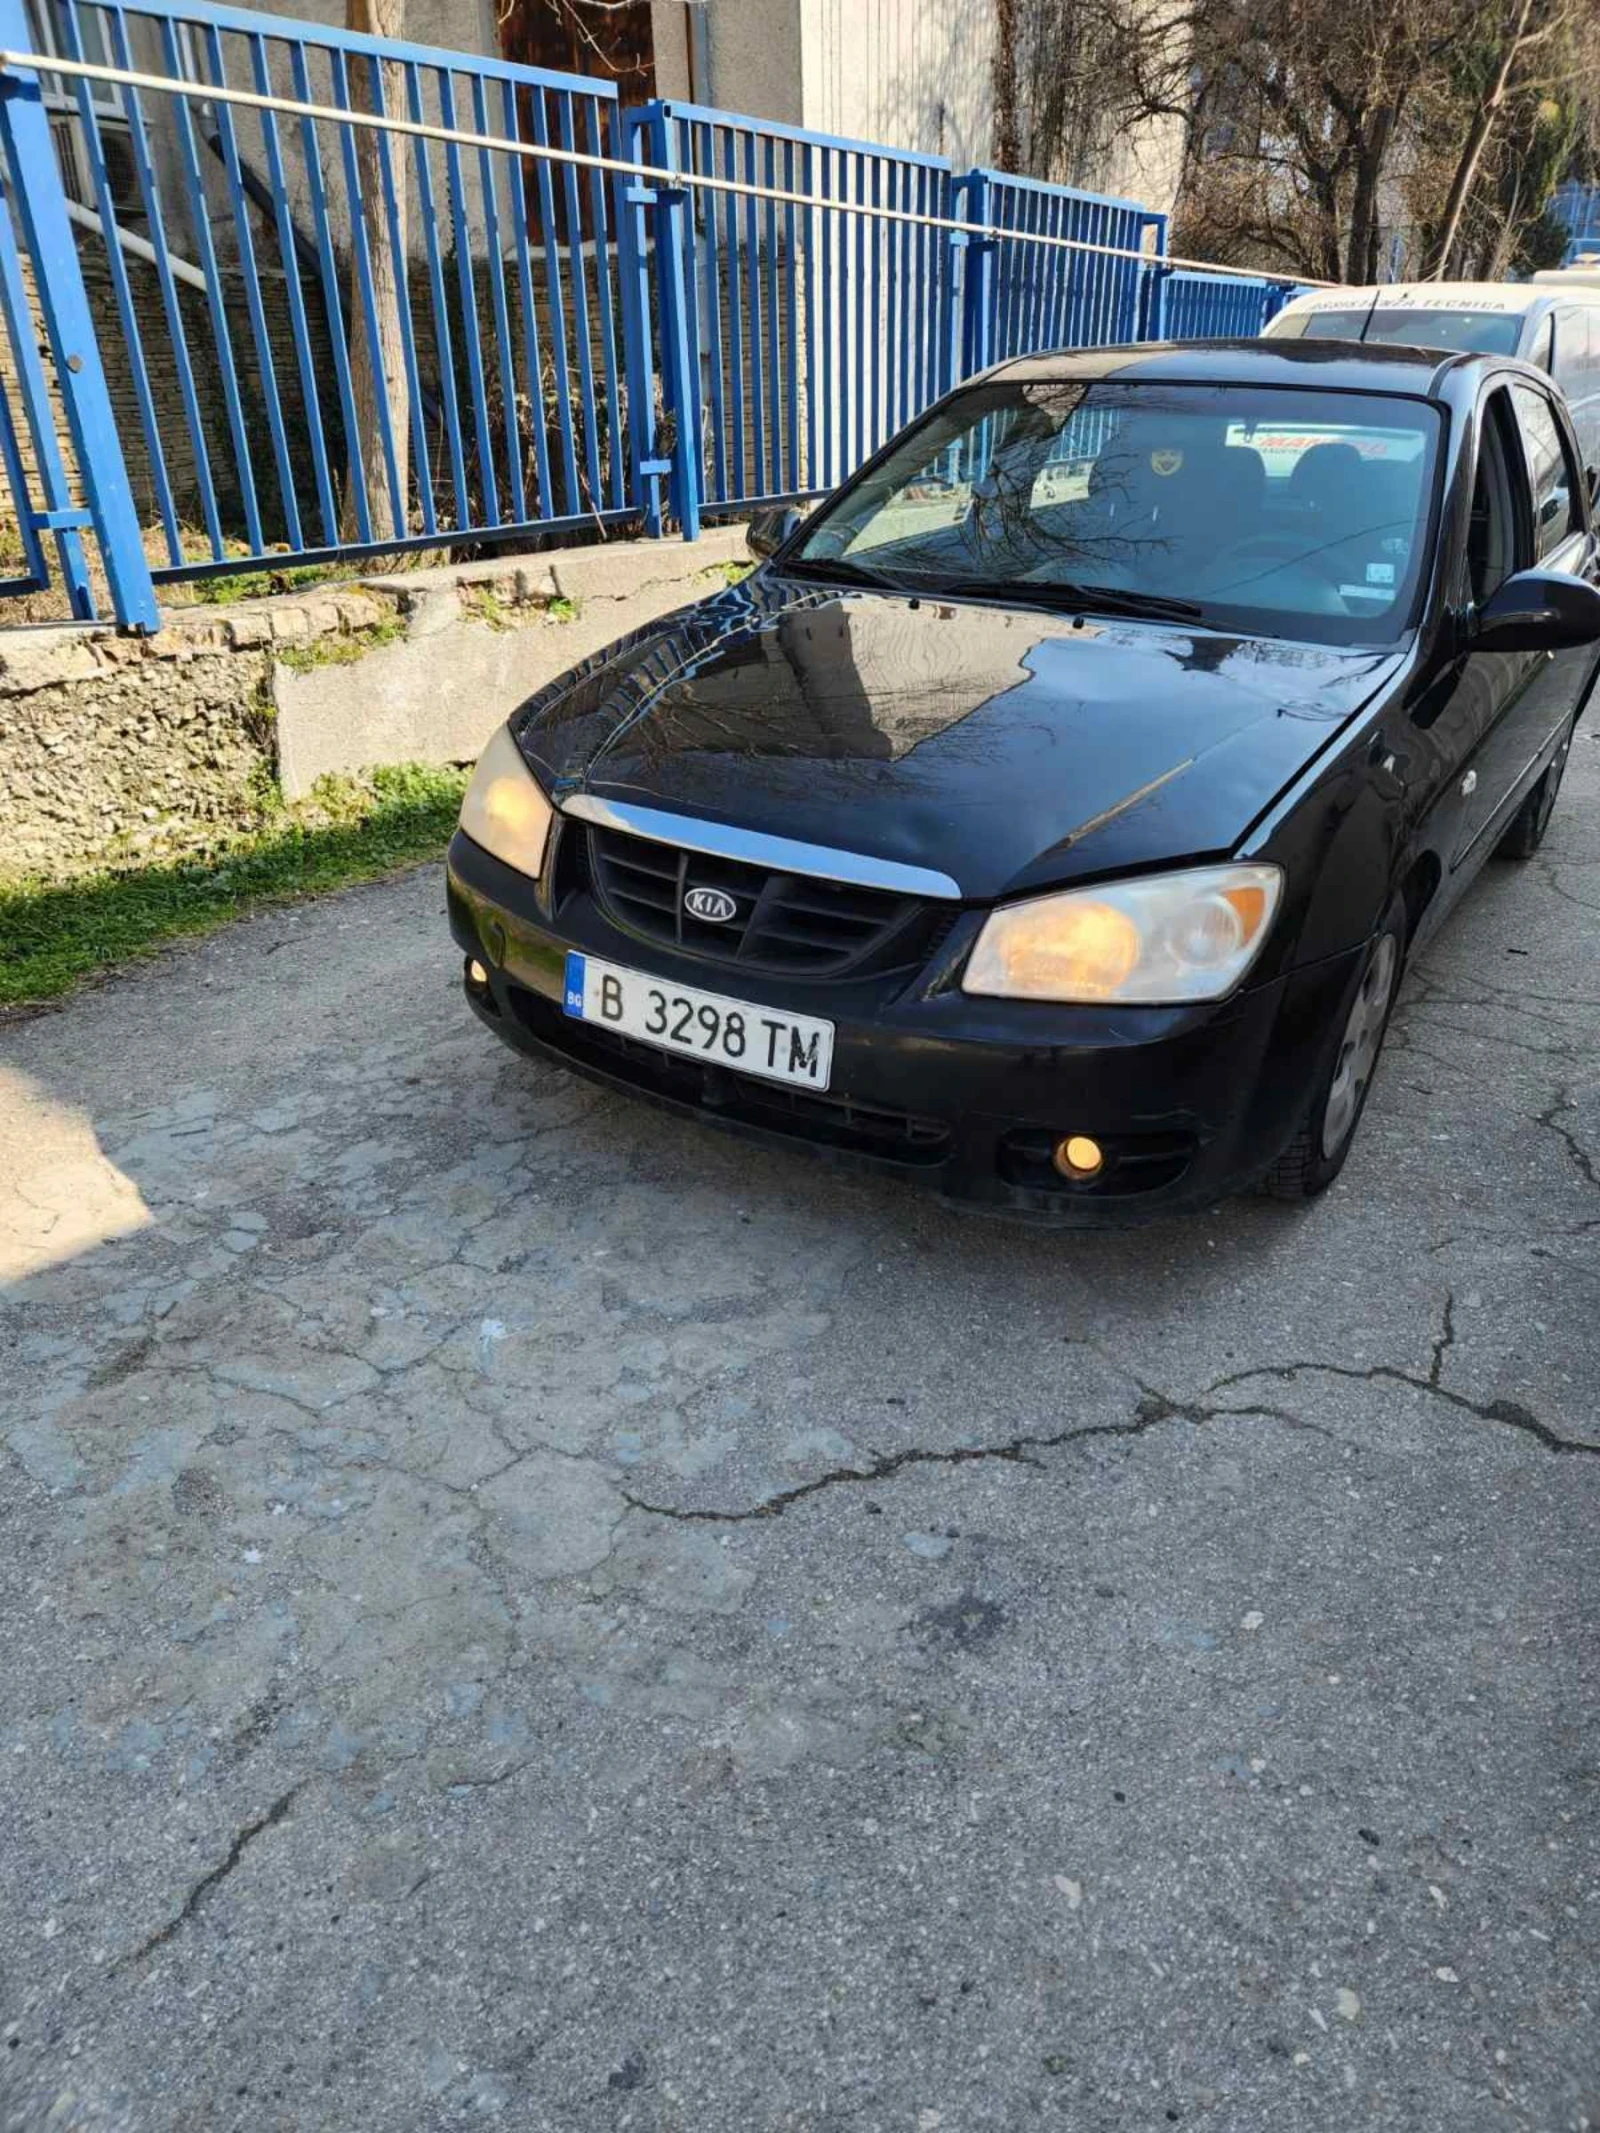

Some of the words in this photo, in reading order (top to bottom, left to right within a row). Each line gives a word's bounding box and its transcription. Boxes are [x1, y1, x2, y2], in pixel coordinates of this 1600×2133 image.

[1422, 299, 1505, 310] TECNICA
[691, 894, 728, 916] KIA
[567, 991, 582, 1007] BG
[602, 974, 623, 1021] B
[645, 990, 746, 1057] 3298
[761, 1019, 820, 1077] TM
